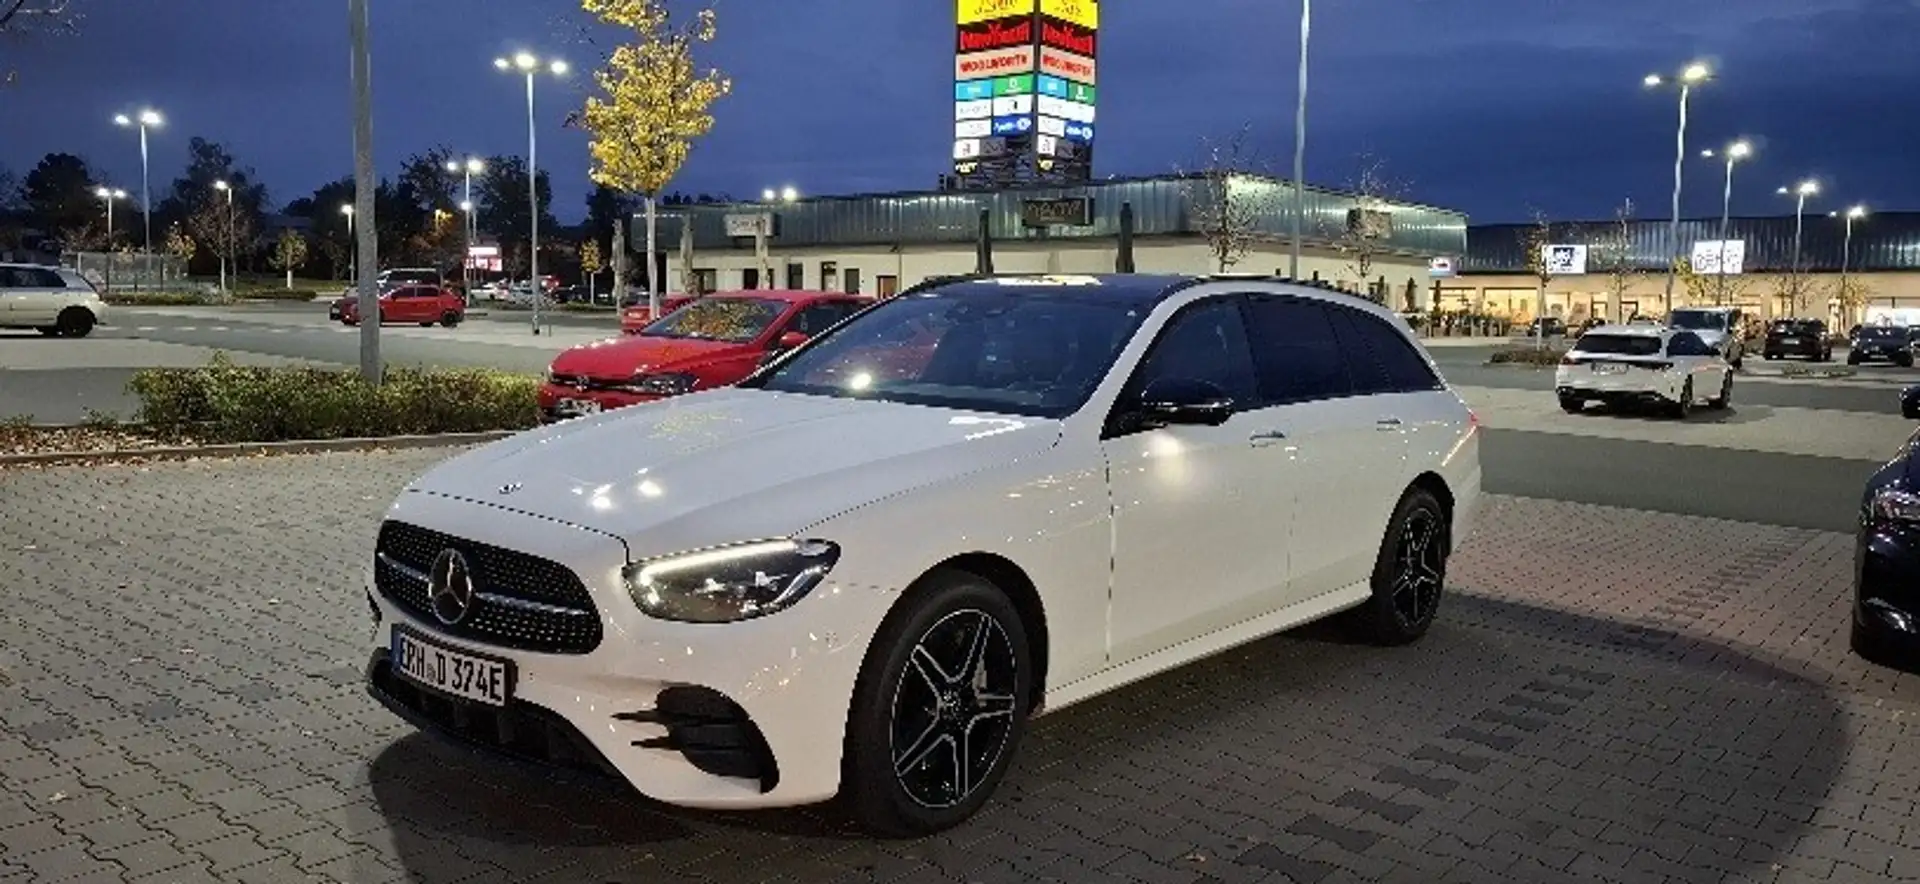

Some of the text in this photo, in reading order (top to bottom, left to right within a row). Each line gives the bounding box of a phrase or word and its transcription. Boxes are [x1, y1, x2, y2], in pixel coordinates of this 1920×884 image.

[401, 637, 502, 702] ERH D 374E
